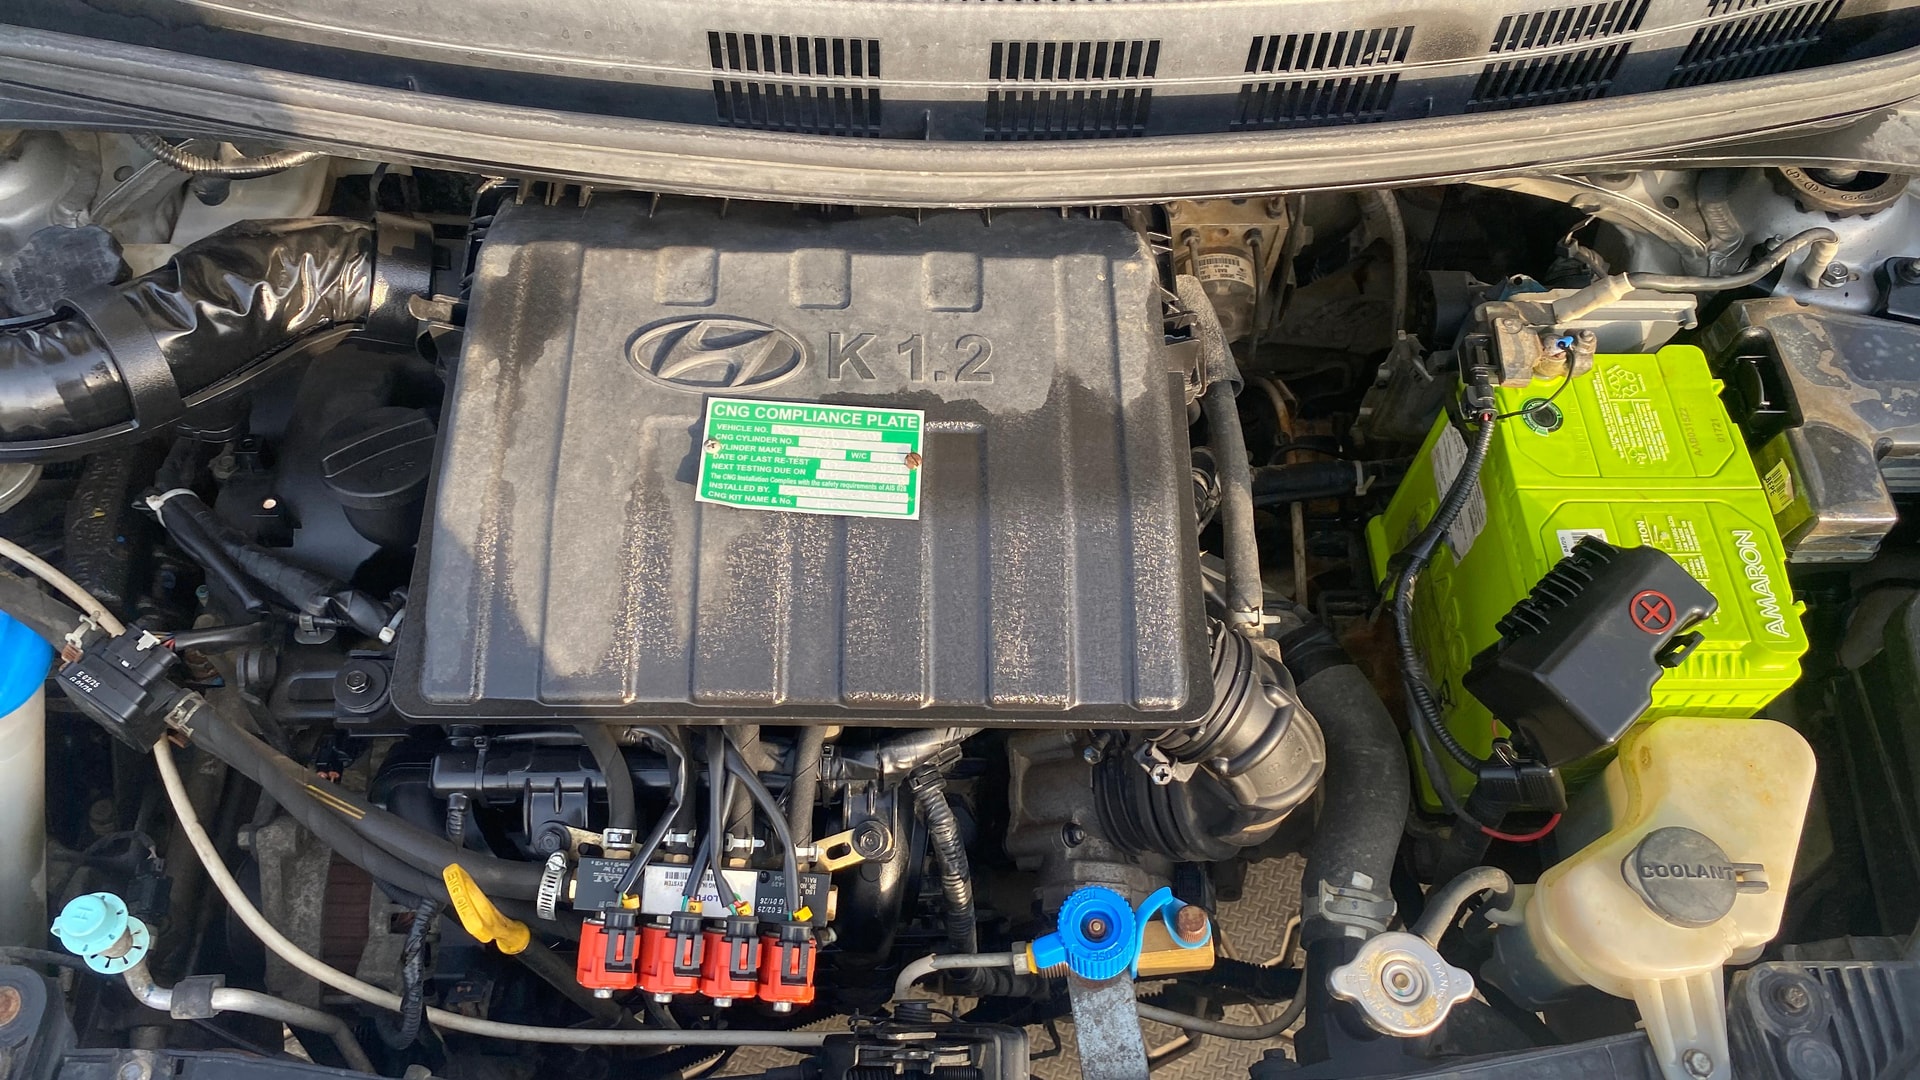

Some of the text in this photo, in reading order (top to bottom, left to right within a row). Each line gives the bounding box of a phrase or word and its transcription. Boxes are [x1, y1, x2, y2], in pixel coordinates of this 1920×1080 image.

[828, 331, 994, 384] K 1.2
[713, 403, 917, 428] CNG COMPLIANCE PLATE
[716, 423, 752, 432] VEHICLE
[735, 434, 778, 443] CYLINDER
[718, 442, 755, 452] YLINDER
[750, 455, 772, 463] LAST
[774, 456, 809, 466] RE-TEST
[736, 464, 771, 472] TESTING
[708, 481, 755, 492] INSTALLED
[737, 474, 768, 482] Installation
[769, 476, 796, 486] Complies
[821, 480, 838, 488] safety
[839, 481, 876, 491] requirements
[707, 490, 727, 499] CNG
[744, 494, 768, 502] NAME
[1732, 530, 1790, 638] AMARON
[1640, 864, 1734, 881] COOLANT
[446, 870, 469, 916] ENG OIL
